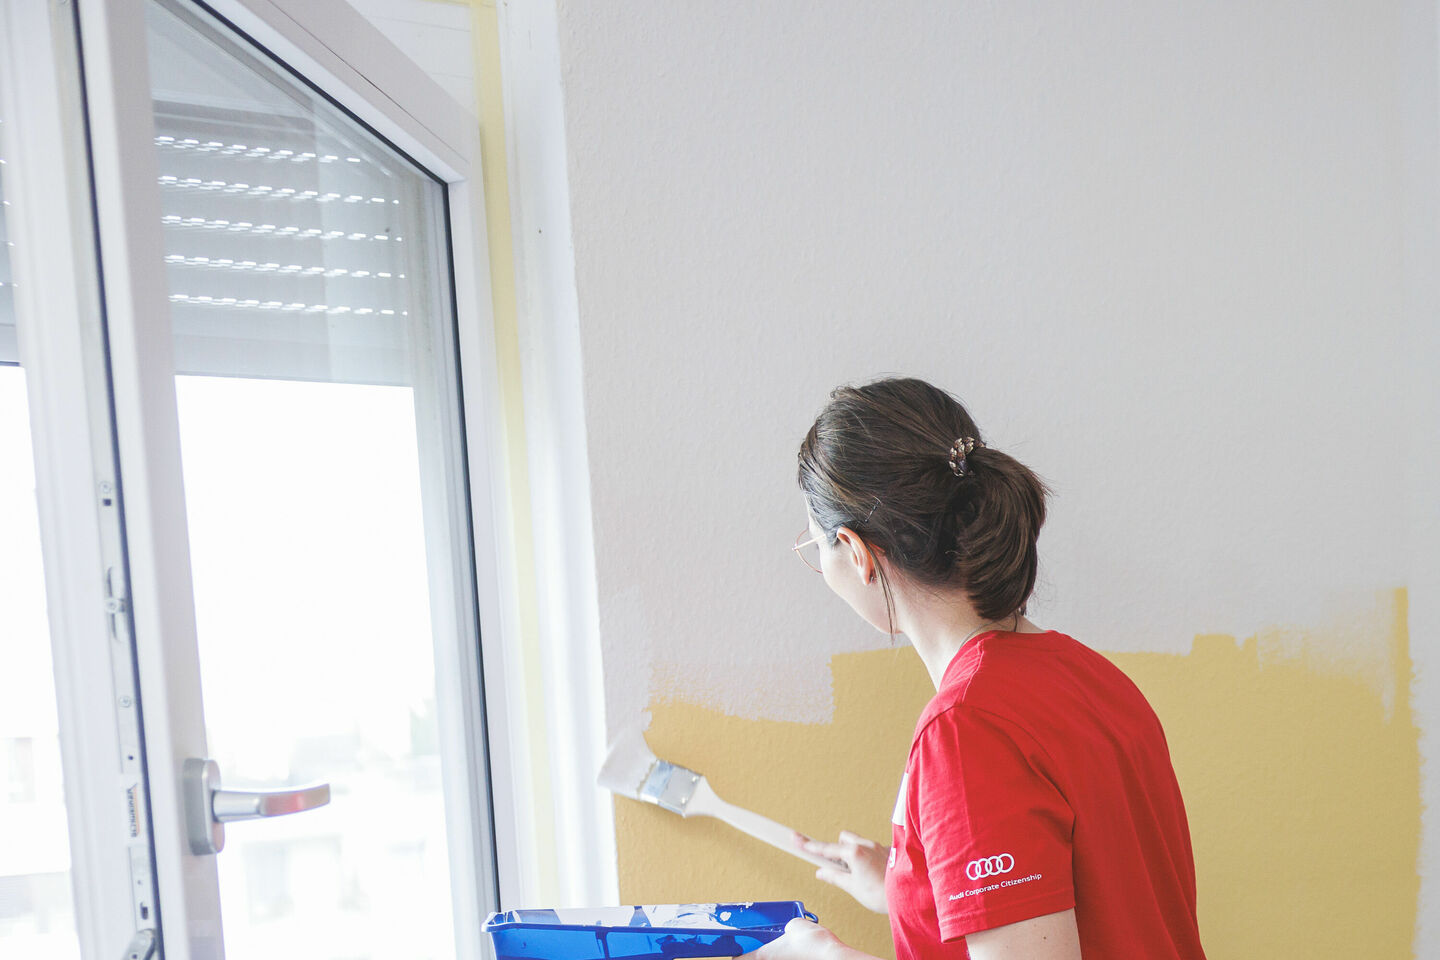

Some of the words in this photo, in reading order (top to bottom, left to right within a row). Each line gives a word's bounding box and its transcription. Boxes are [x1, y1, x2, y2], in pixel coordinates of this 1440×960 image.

[948, 891, 964, 902] Audi
[965, 883, 1000, 898] Corporate
[1000, 873, 1042, 888] Citizenship
